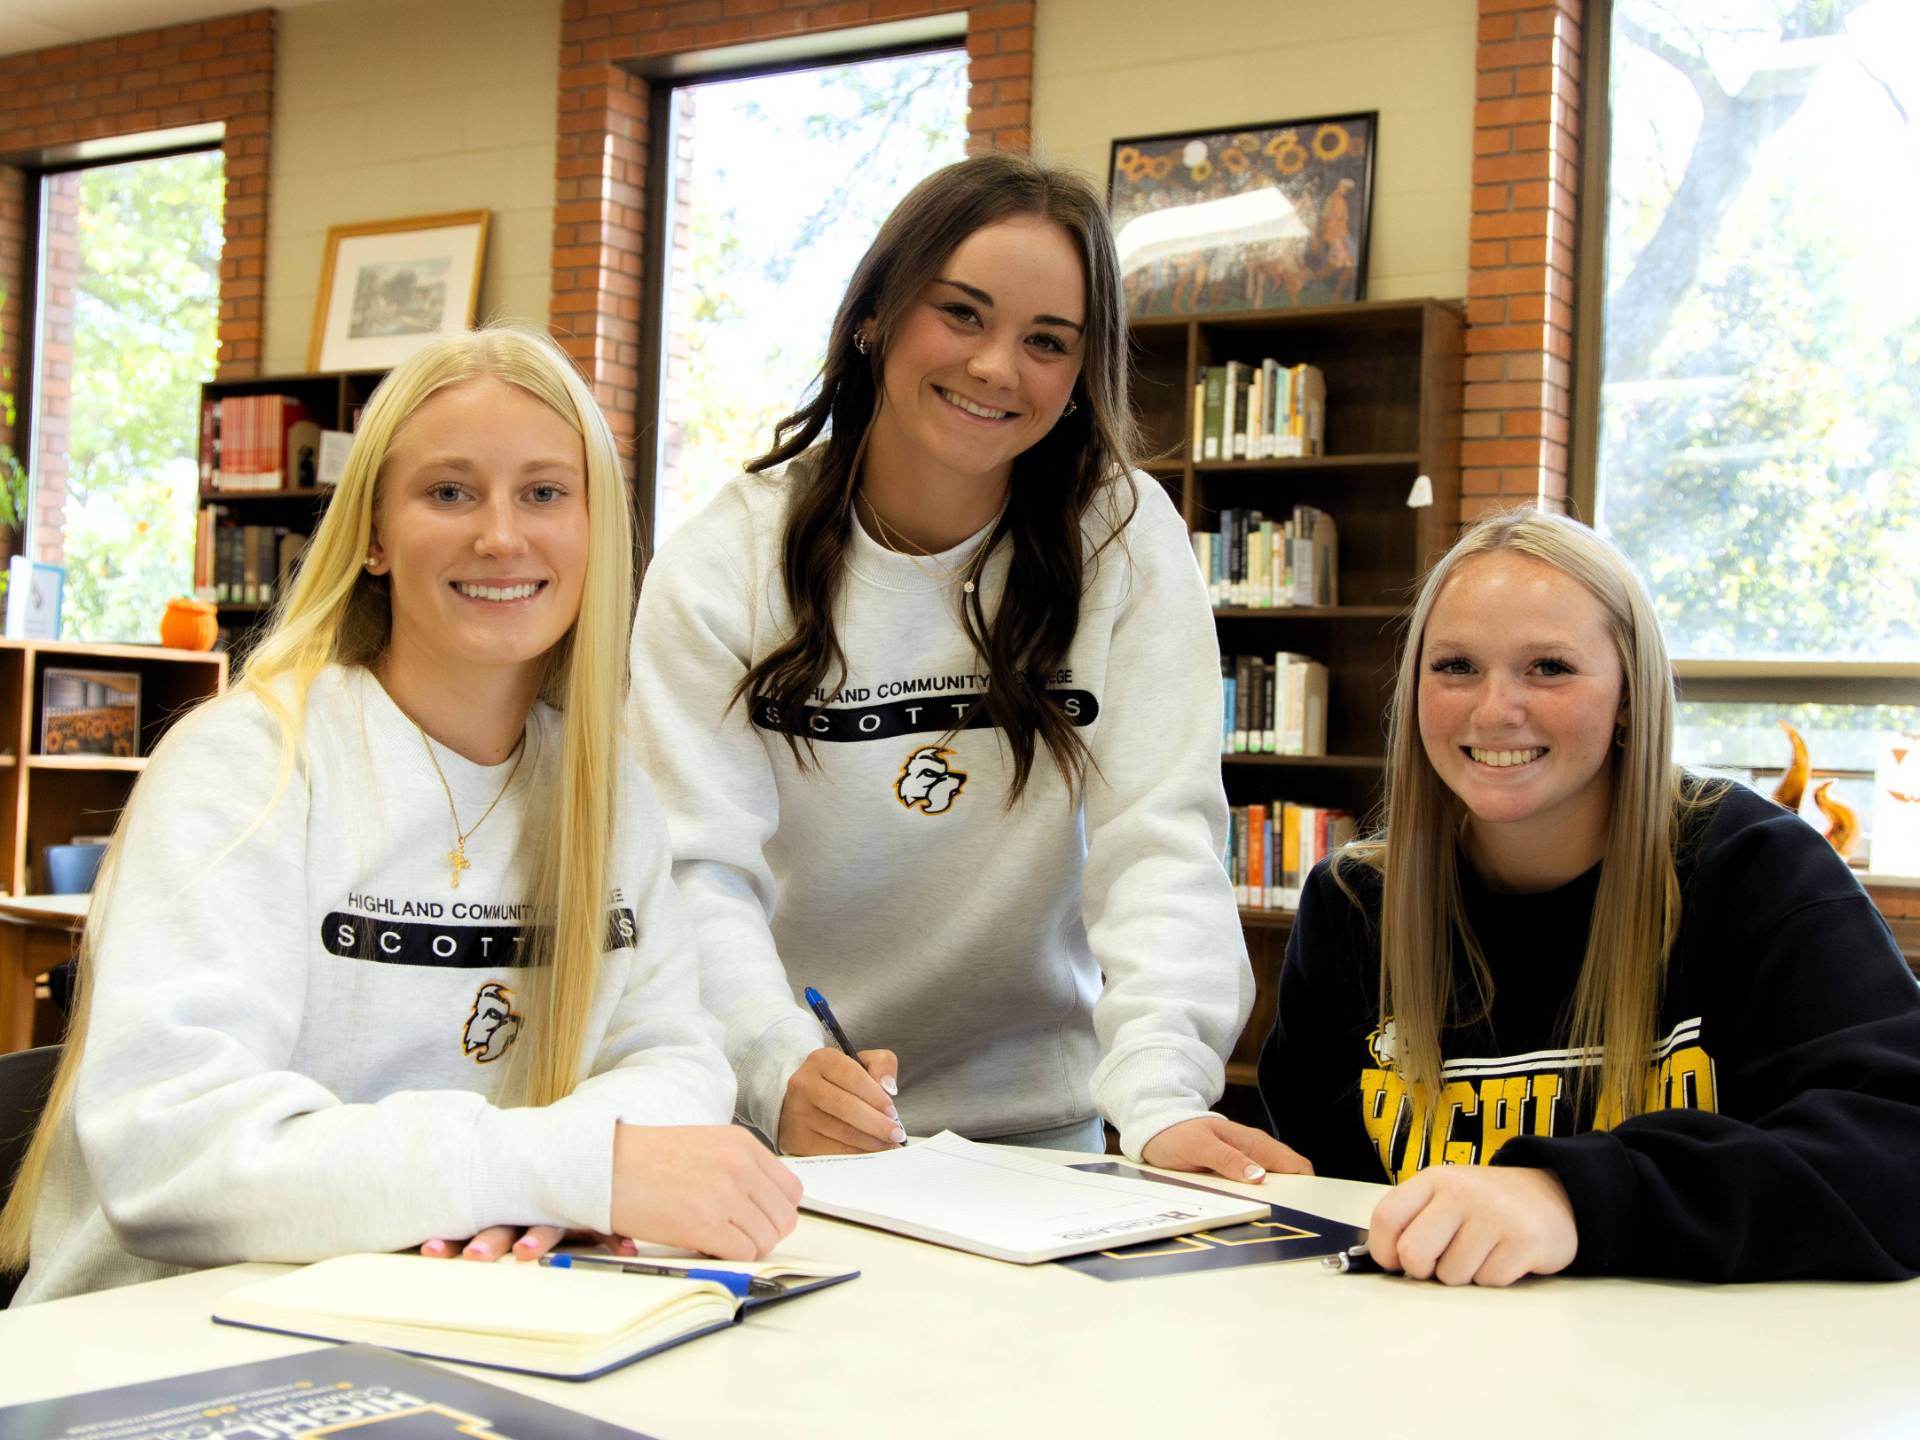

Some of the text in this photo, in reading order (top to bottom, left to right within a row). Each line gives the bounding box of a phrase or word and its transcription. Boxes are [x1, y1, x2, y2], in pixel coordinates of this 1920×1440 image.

[877, 674, 990, 699] COMMUNITY
[765, 697, 1081, 733] SCOTTS
[347, 891, 444, 918] HIGHLAND
[337, 917, 635, 958] SCOTTS
[1360, 1045, 1719, 1186] HIGHLD
[210, 1391, 425, 1440] HIGHL
